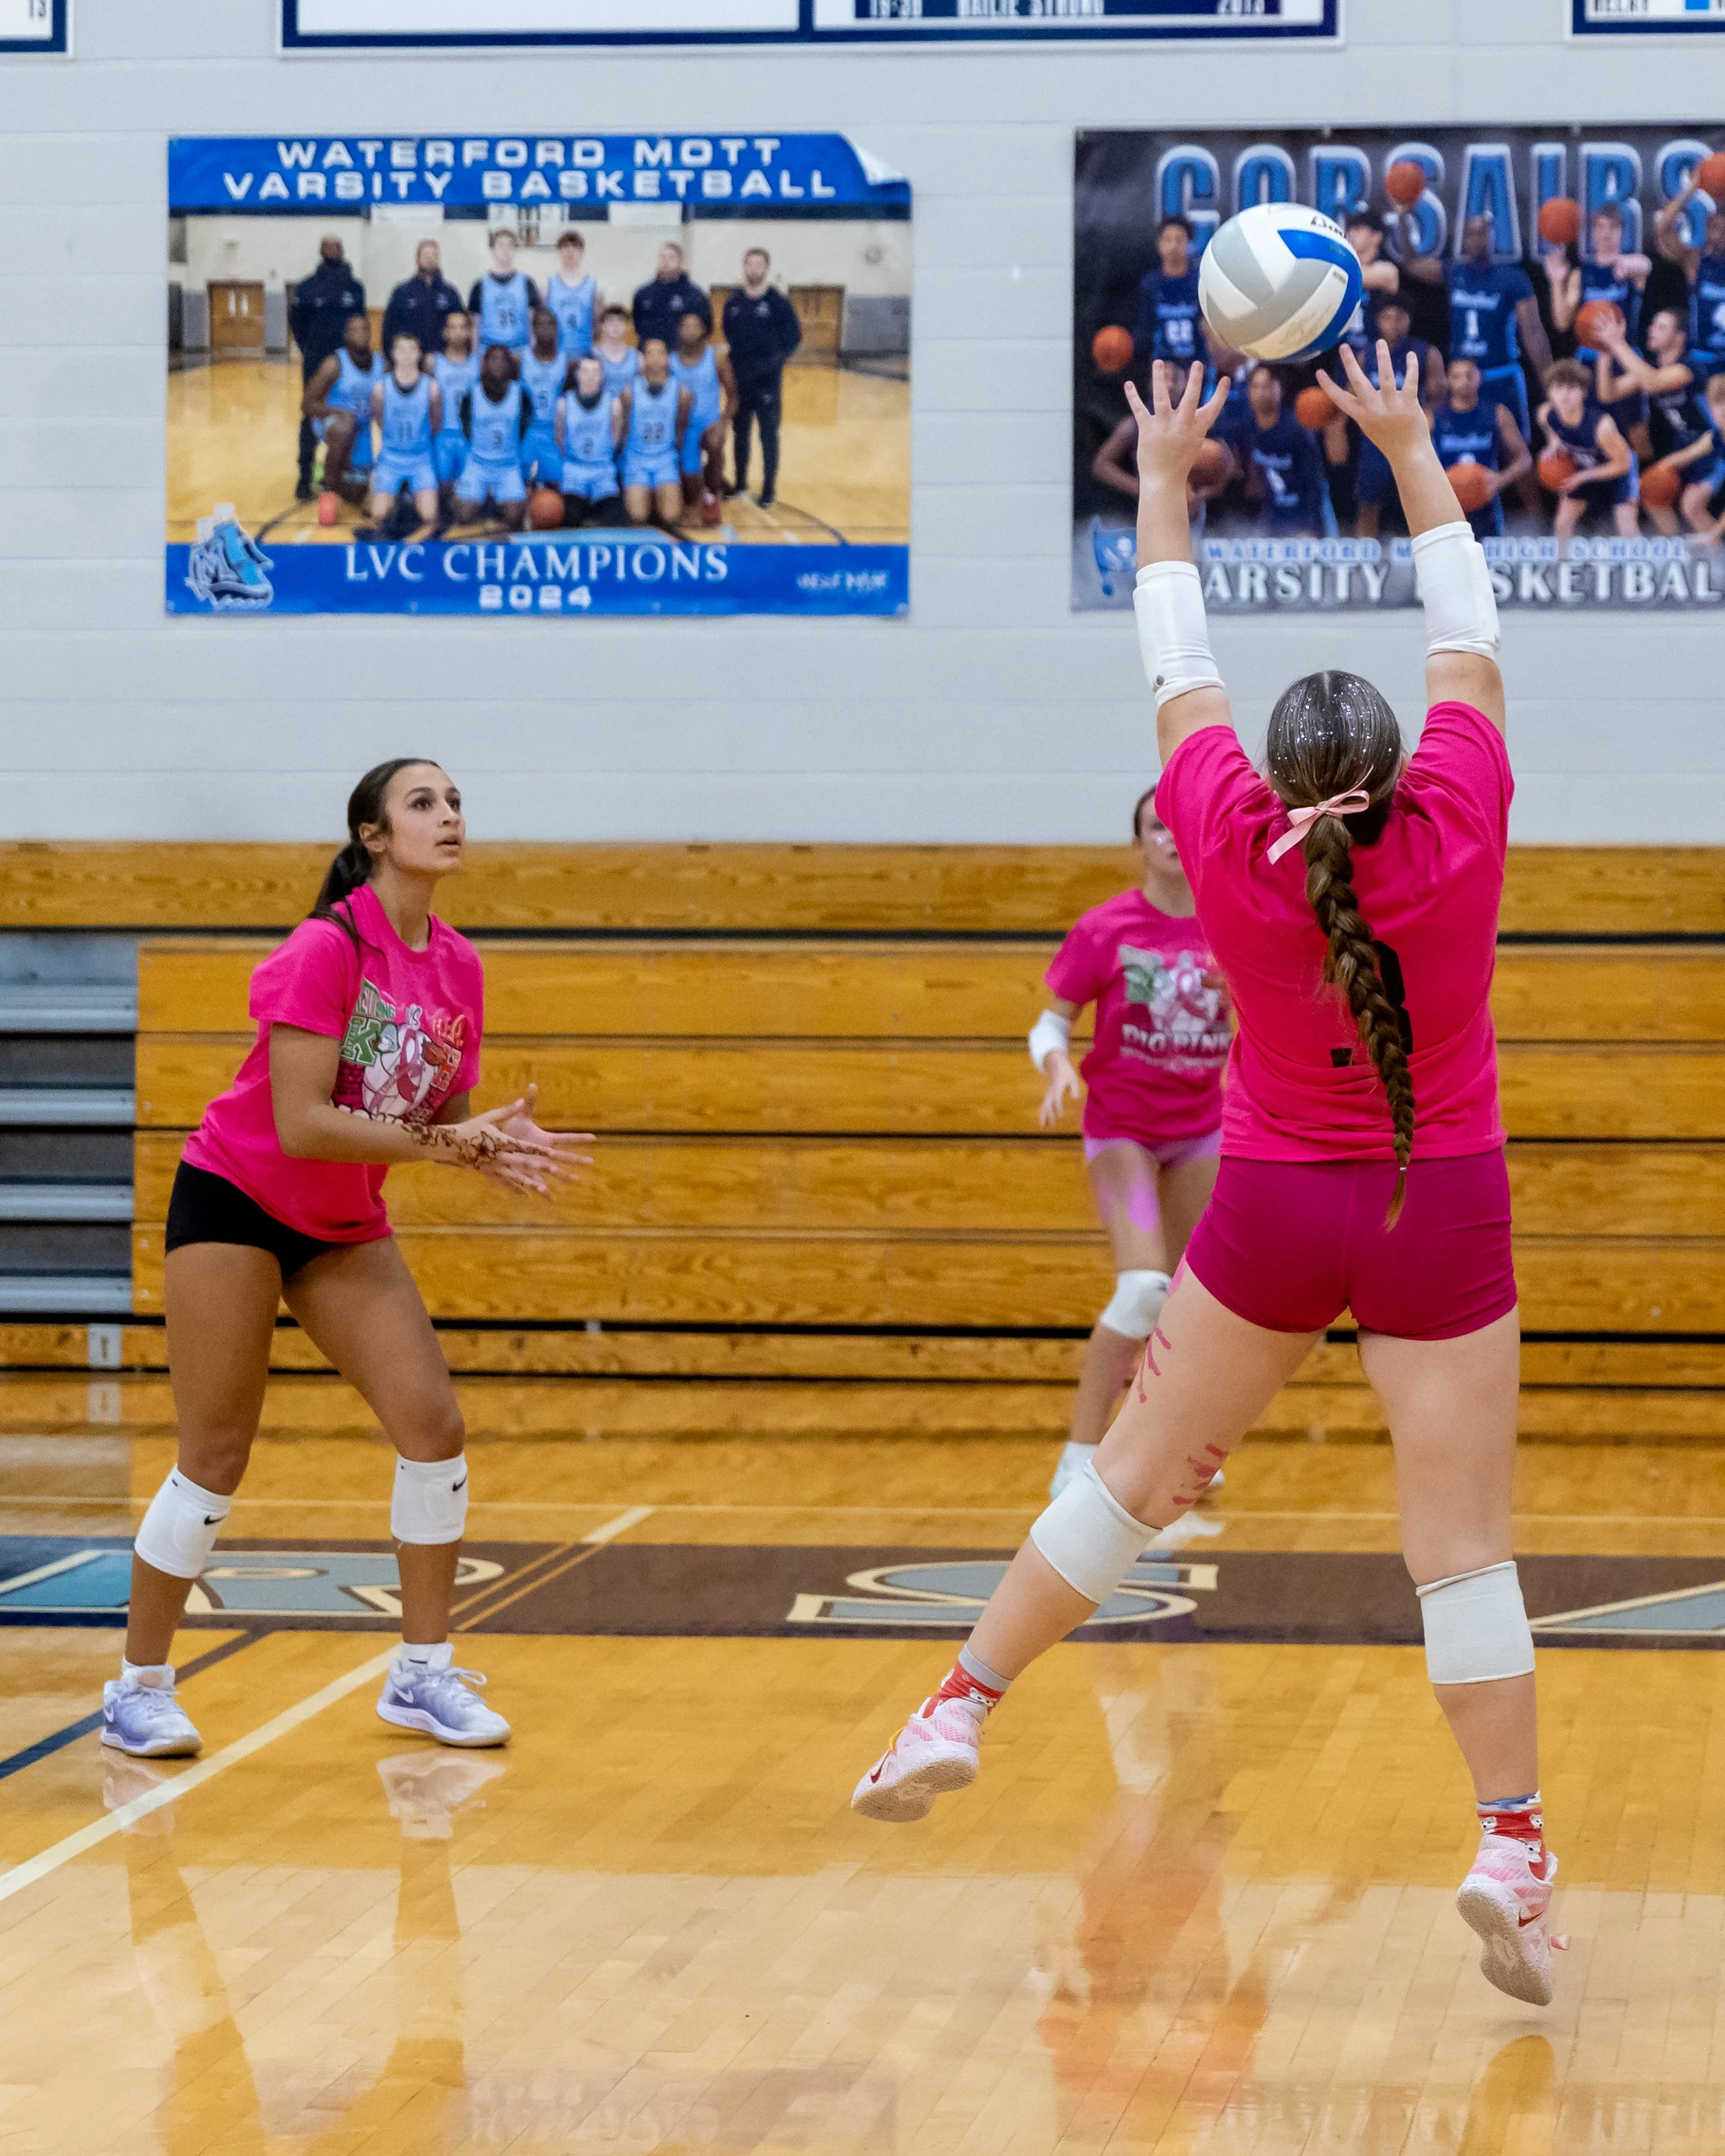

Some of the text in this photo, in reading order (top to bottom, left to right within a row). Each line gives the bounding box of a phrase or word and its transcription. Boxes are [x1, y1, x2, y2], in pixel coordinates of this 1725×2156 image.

[277, 138, 780, 168] WATERFORD MOTT
[223, 169, 836, 201] VARSITY BASKETBALL
[346, 544, 729, 582] LVC CHAMPIONS
[1204, 538, 1381, 564] WATERFORD
[1567, 537, 1686, 562] SCHOOL
[479, 583, 591, 610] 2024
[1205, 560, 1725, 604] ARSITY SKETBAL
